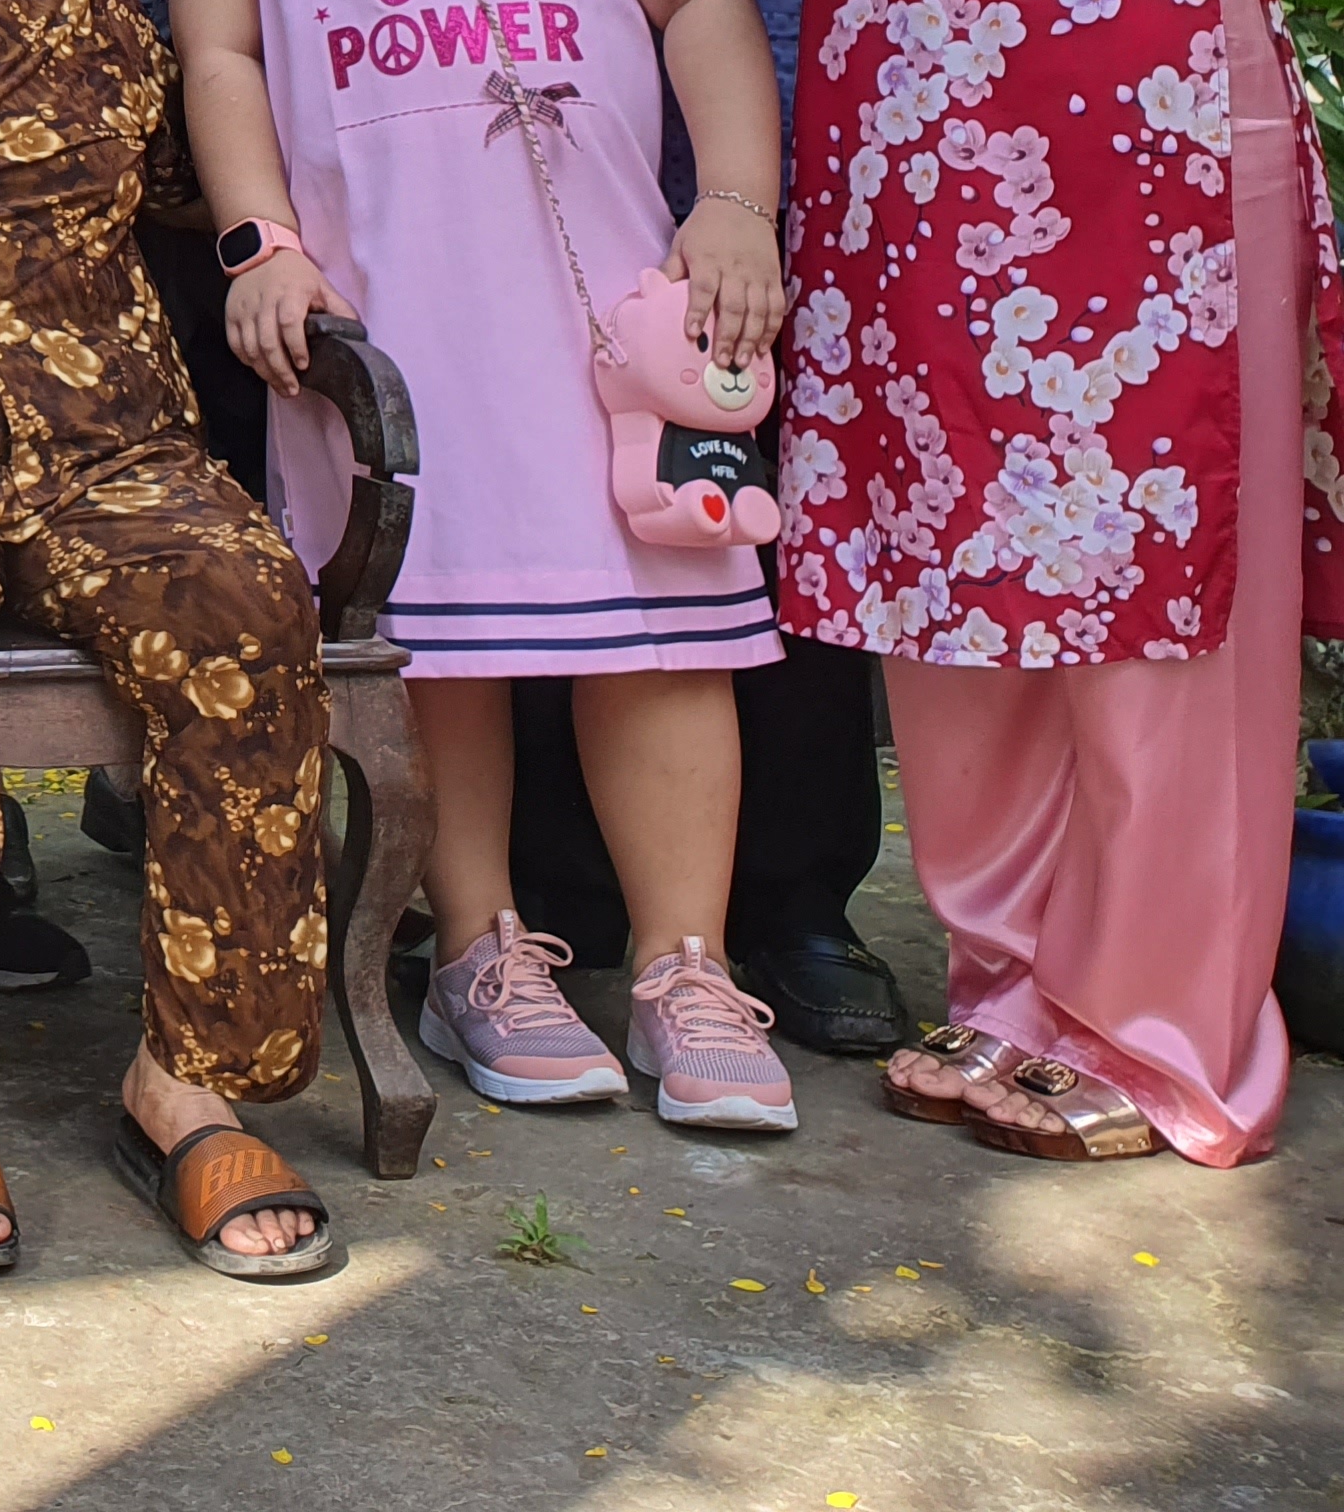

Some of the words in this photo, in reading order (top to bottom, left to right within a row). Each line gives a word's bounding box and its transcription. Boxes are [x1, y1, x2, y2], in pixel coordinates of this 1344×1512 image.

[327, 1, 583, 90] POWER
[690, 439, 722, 459] LOVE
[723, 441, 748, 465] BABY
